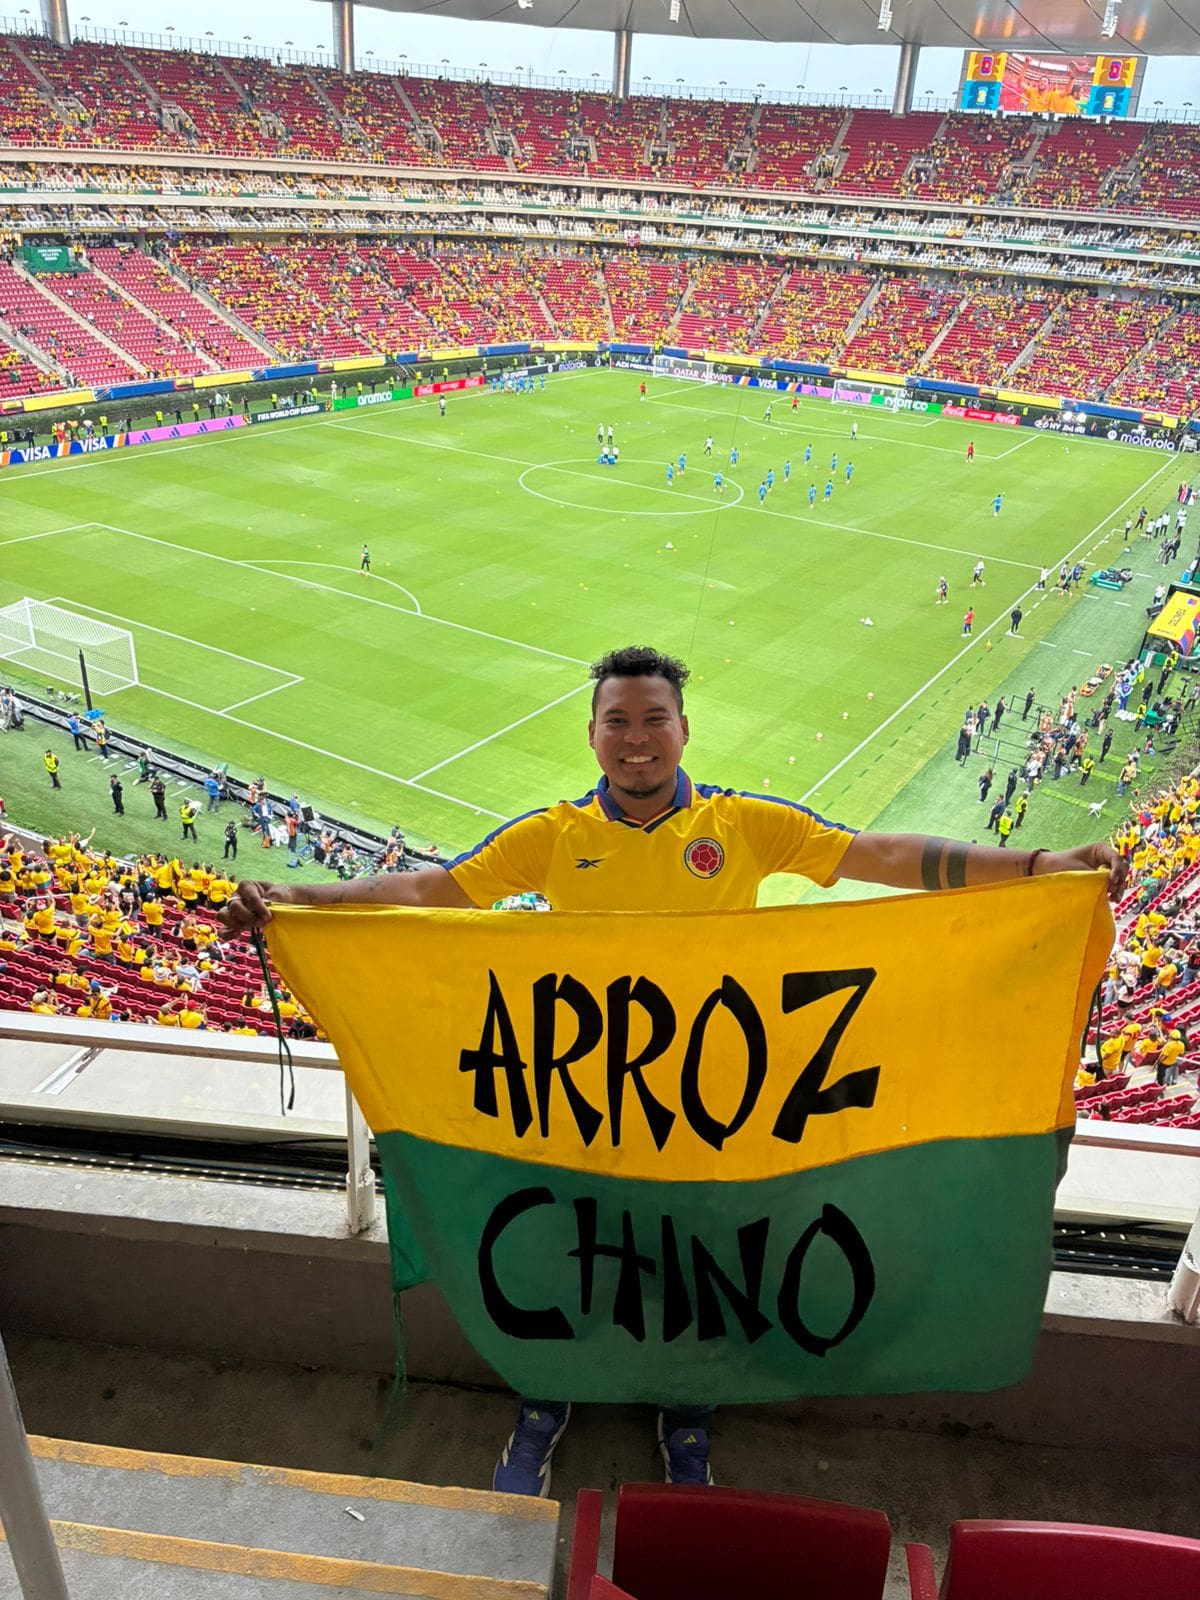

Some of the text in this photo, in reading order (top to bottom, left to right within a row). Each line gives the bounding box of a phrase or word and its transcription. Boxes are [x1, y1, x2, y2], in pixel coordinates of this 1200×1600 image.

[673, 367, 699, 377] QATAR
[758, 378, 778, 389] VISA
[357, 390, 393, 406] aramco
[257, 413, 270, 421] FIFA
[269, 409, 290, 419] WORLD
[289, 407, 300, 416] CUP
[79, 437, 108, 453] VISA
[1120, 433, 1175, 451] motorola
[19, 445, 51, 462] VISA
[458, 967, 881, 1153] ARROZ
[477, 1186, 876, 1358] CHINO
